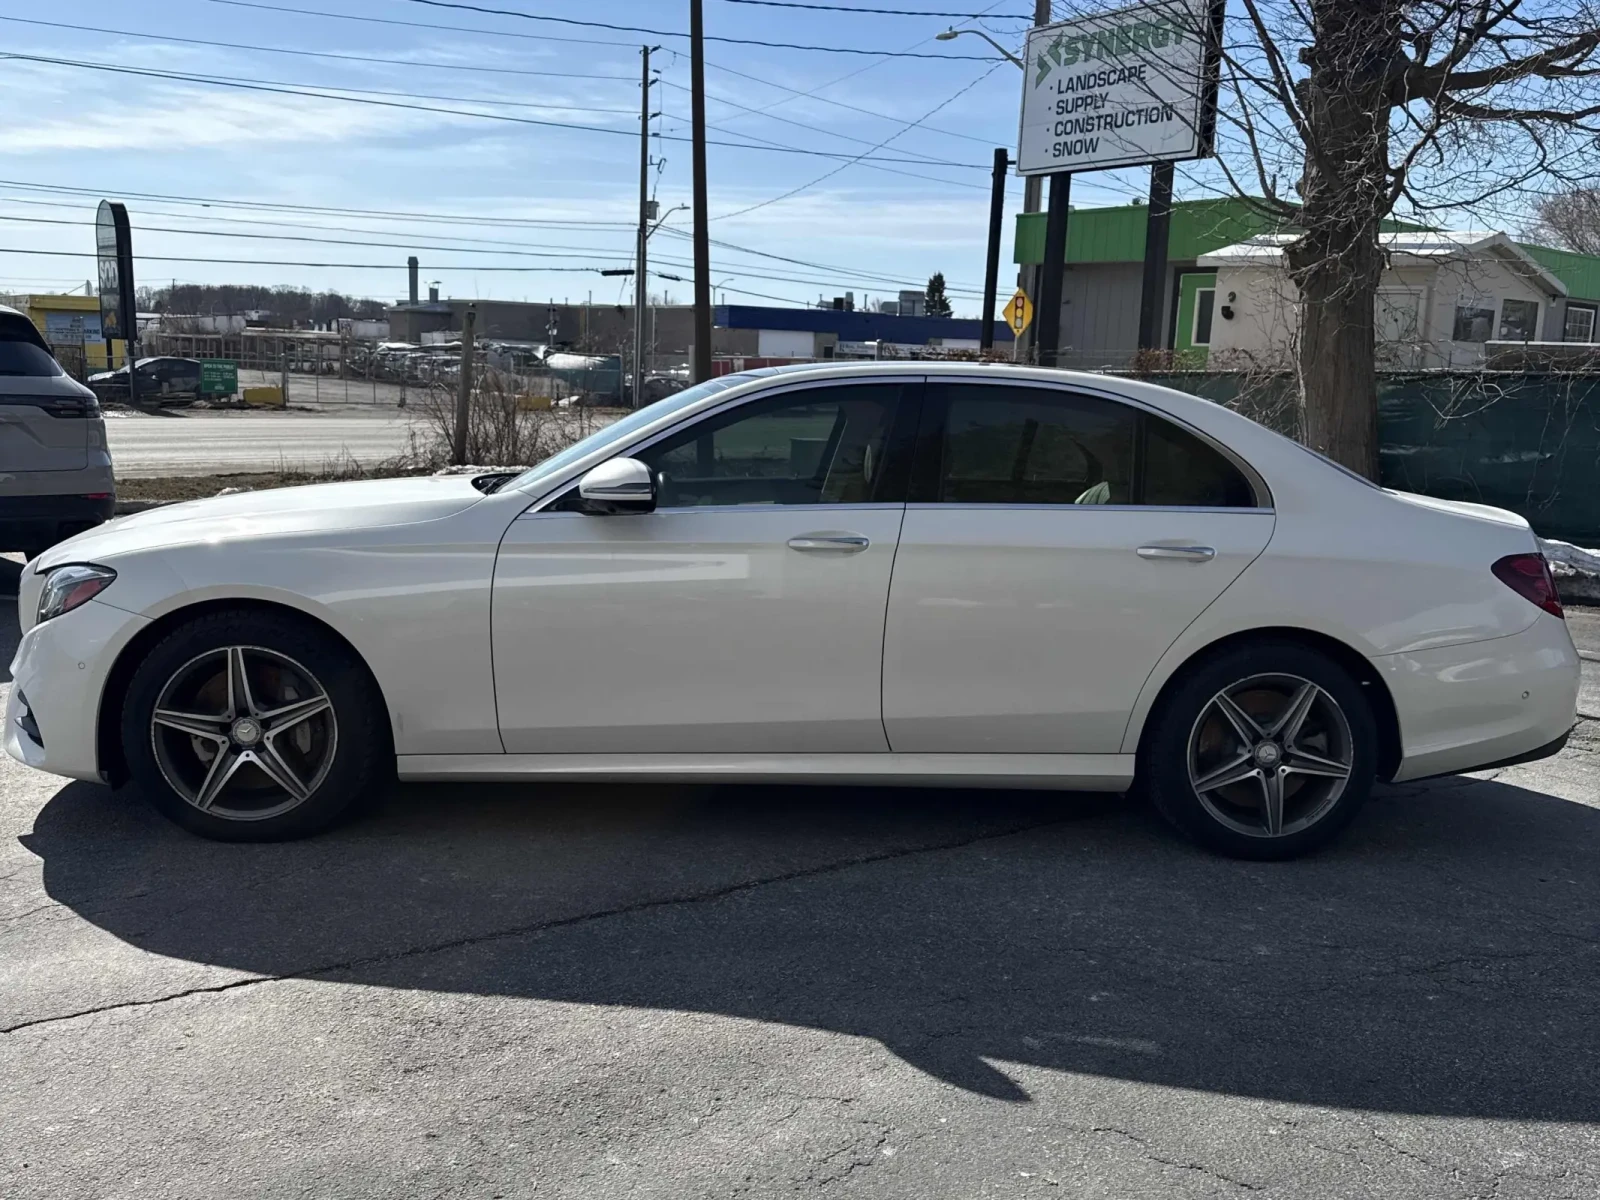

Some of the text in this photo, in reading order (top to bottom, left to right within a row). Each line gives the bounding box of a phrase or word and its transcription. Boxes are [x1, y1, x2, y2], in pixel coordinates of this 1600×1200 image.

[1063, 15, 1189, 67] SYNERGY
[1057, 64, 1147, 95] LANDSCAPE
[1055, 92, 1110, 116] SUPPLY
[1054, 104, 1173, 137] CONSTRUCTION
[1052, 136, 1100, 158] SNOW
[99, 260, 118, 289] SOD
